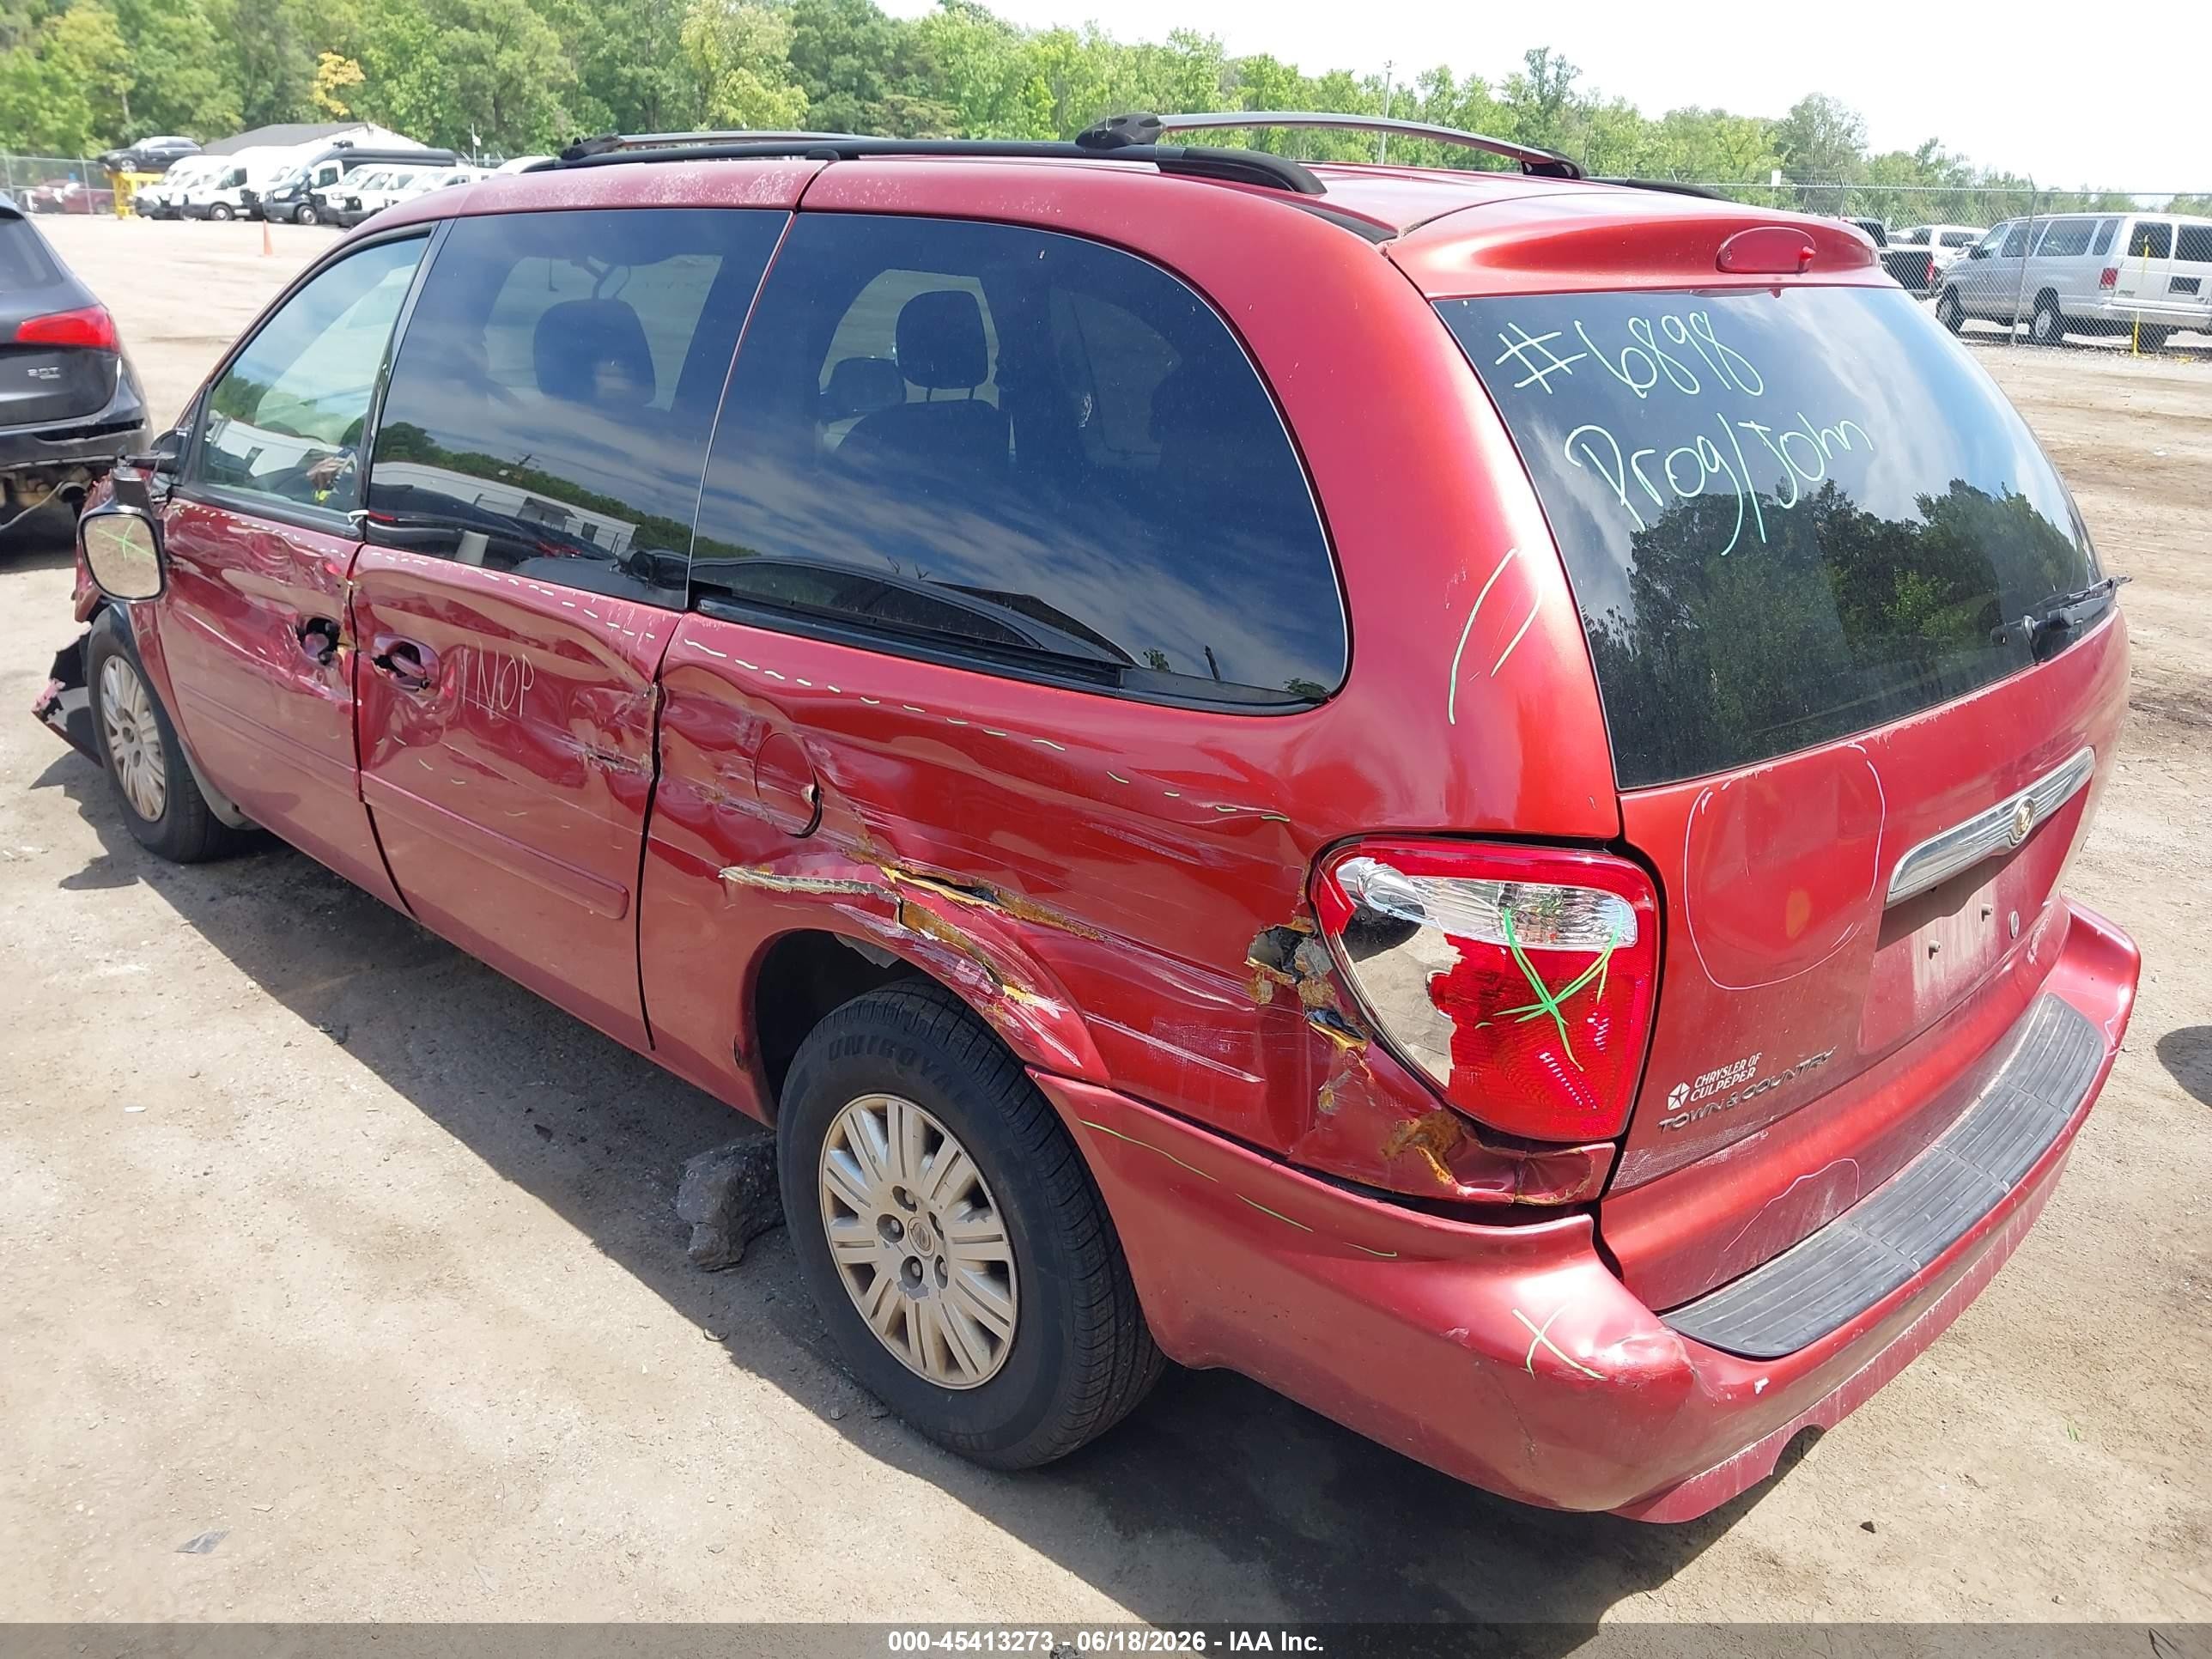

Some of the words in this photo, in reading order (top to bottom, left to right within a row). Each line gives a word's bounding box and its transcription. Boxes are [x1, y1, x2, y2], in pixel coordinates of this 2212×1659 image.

[1495, 310, 1765, 398] #6898
[1658, 1102, 1723, 1133] TOWN
[1726, 1091, 1740, 1109] &
[1742, 1045, 1838, 1100] COUNTRY
[1690, 1066, 1757, 1102] CULPEPER
[1694, 1059, 1747, 1089] CHRYSLER
[1748, 1052, 1762, 1067] OF
